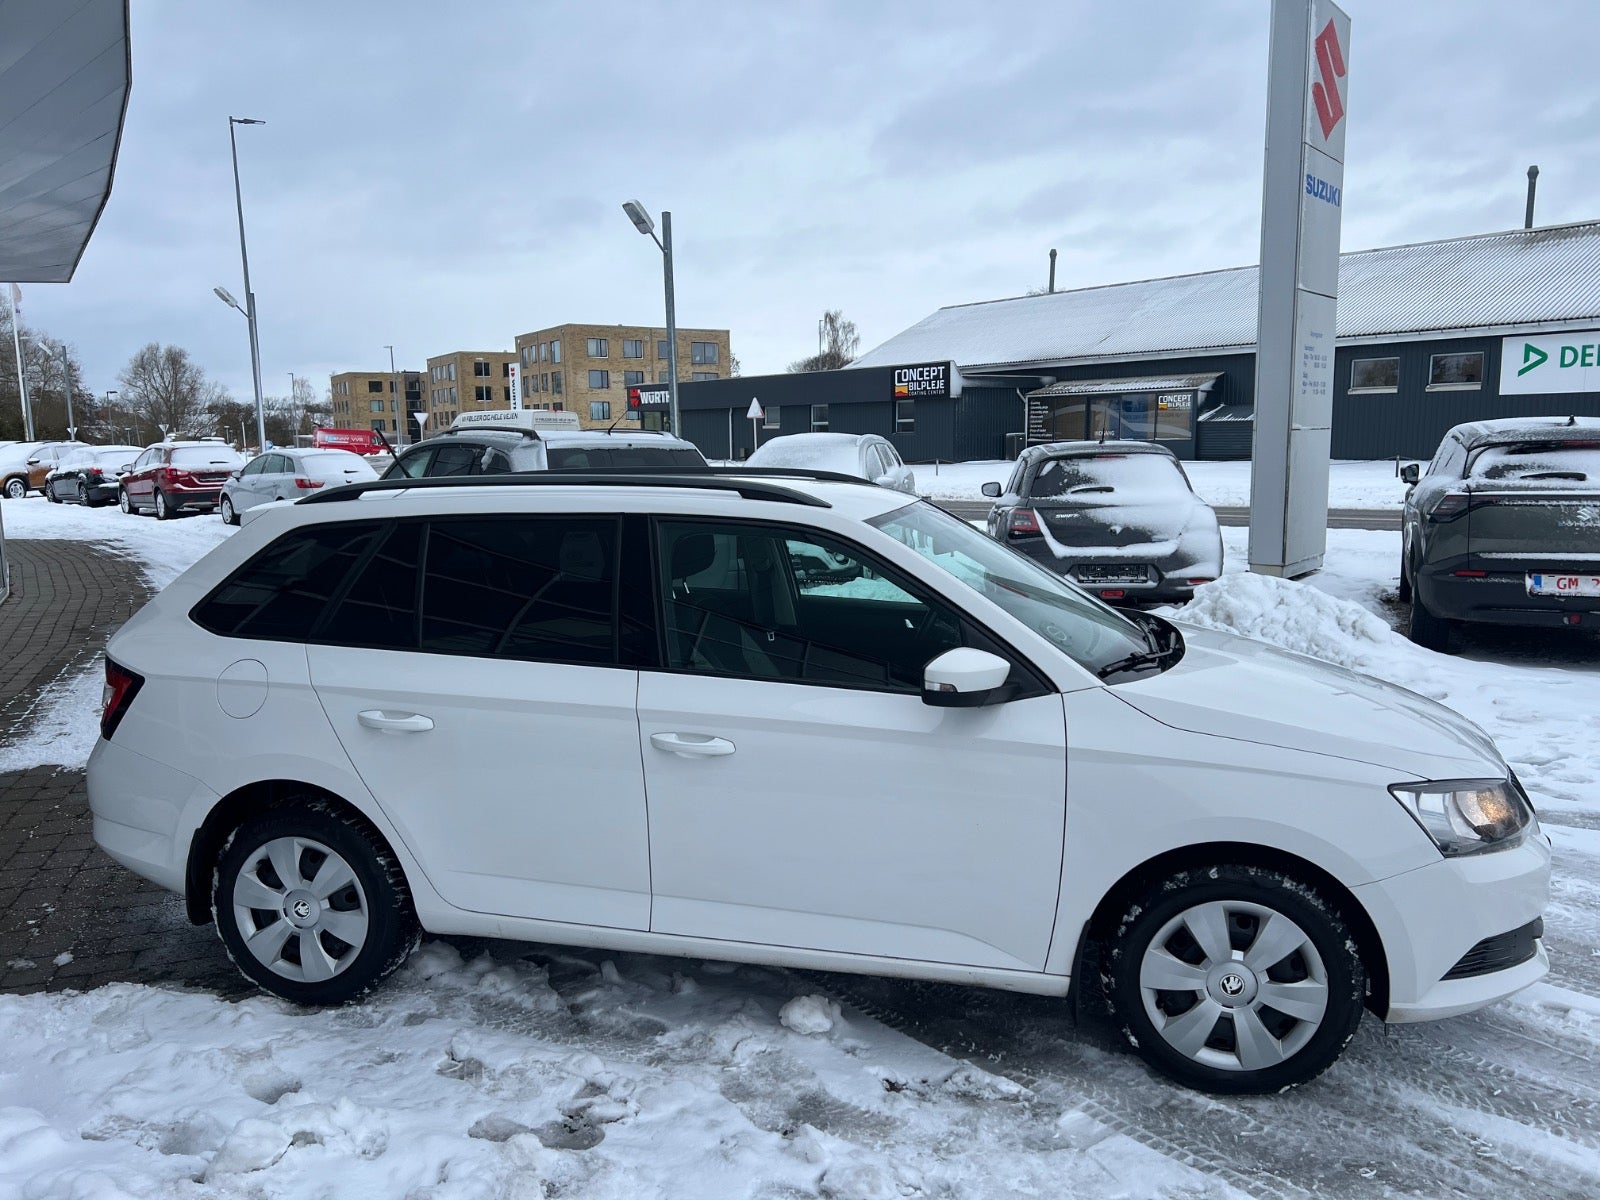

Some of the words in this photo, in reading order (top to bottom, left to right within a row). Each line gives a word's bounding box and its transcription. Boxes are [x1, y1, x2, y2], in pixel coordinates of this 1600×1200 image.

[1306, 174, 1340, 207] SUZUKI
[895, 366, 945, 386] CONCEPT
[908, 380, 945, 391] BILPLEJE
[1158, 394, 1192, 405] CONCEPT
[1556, 577, 1579, 590] GM
